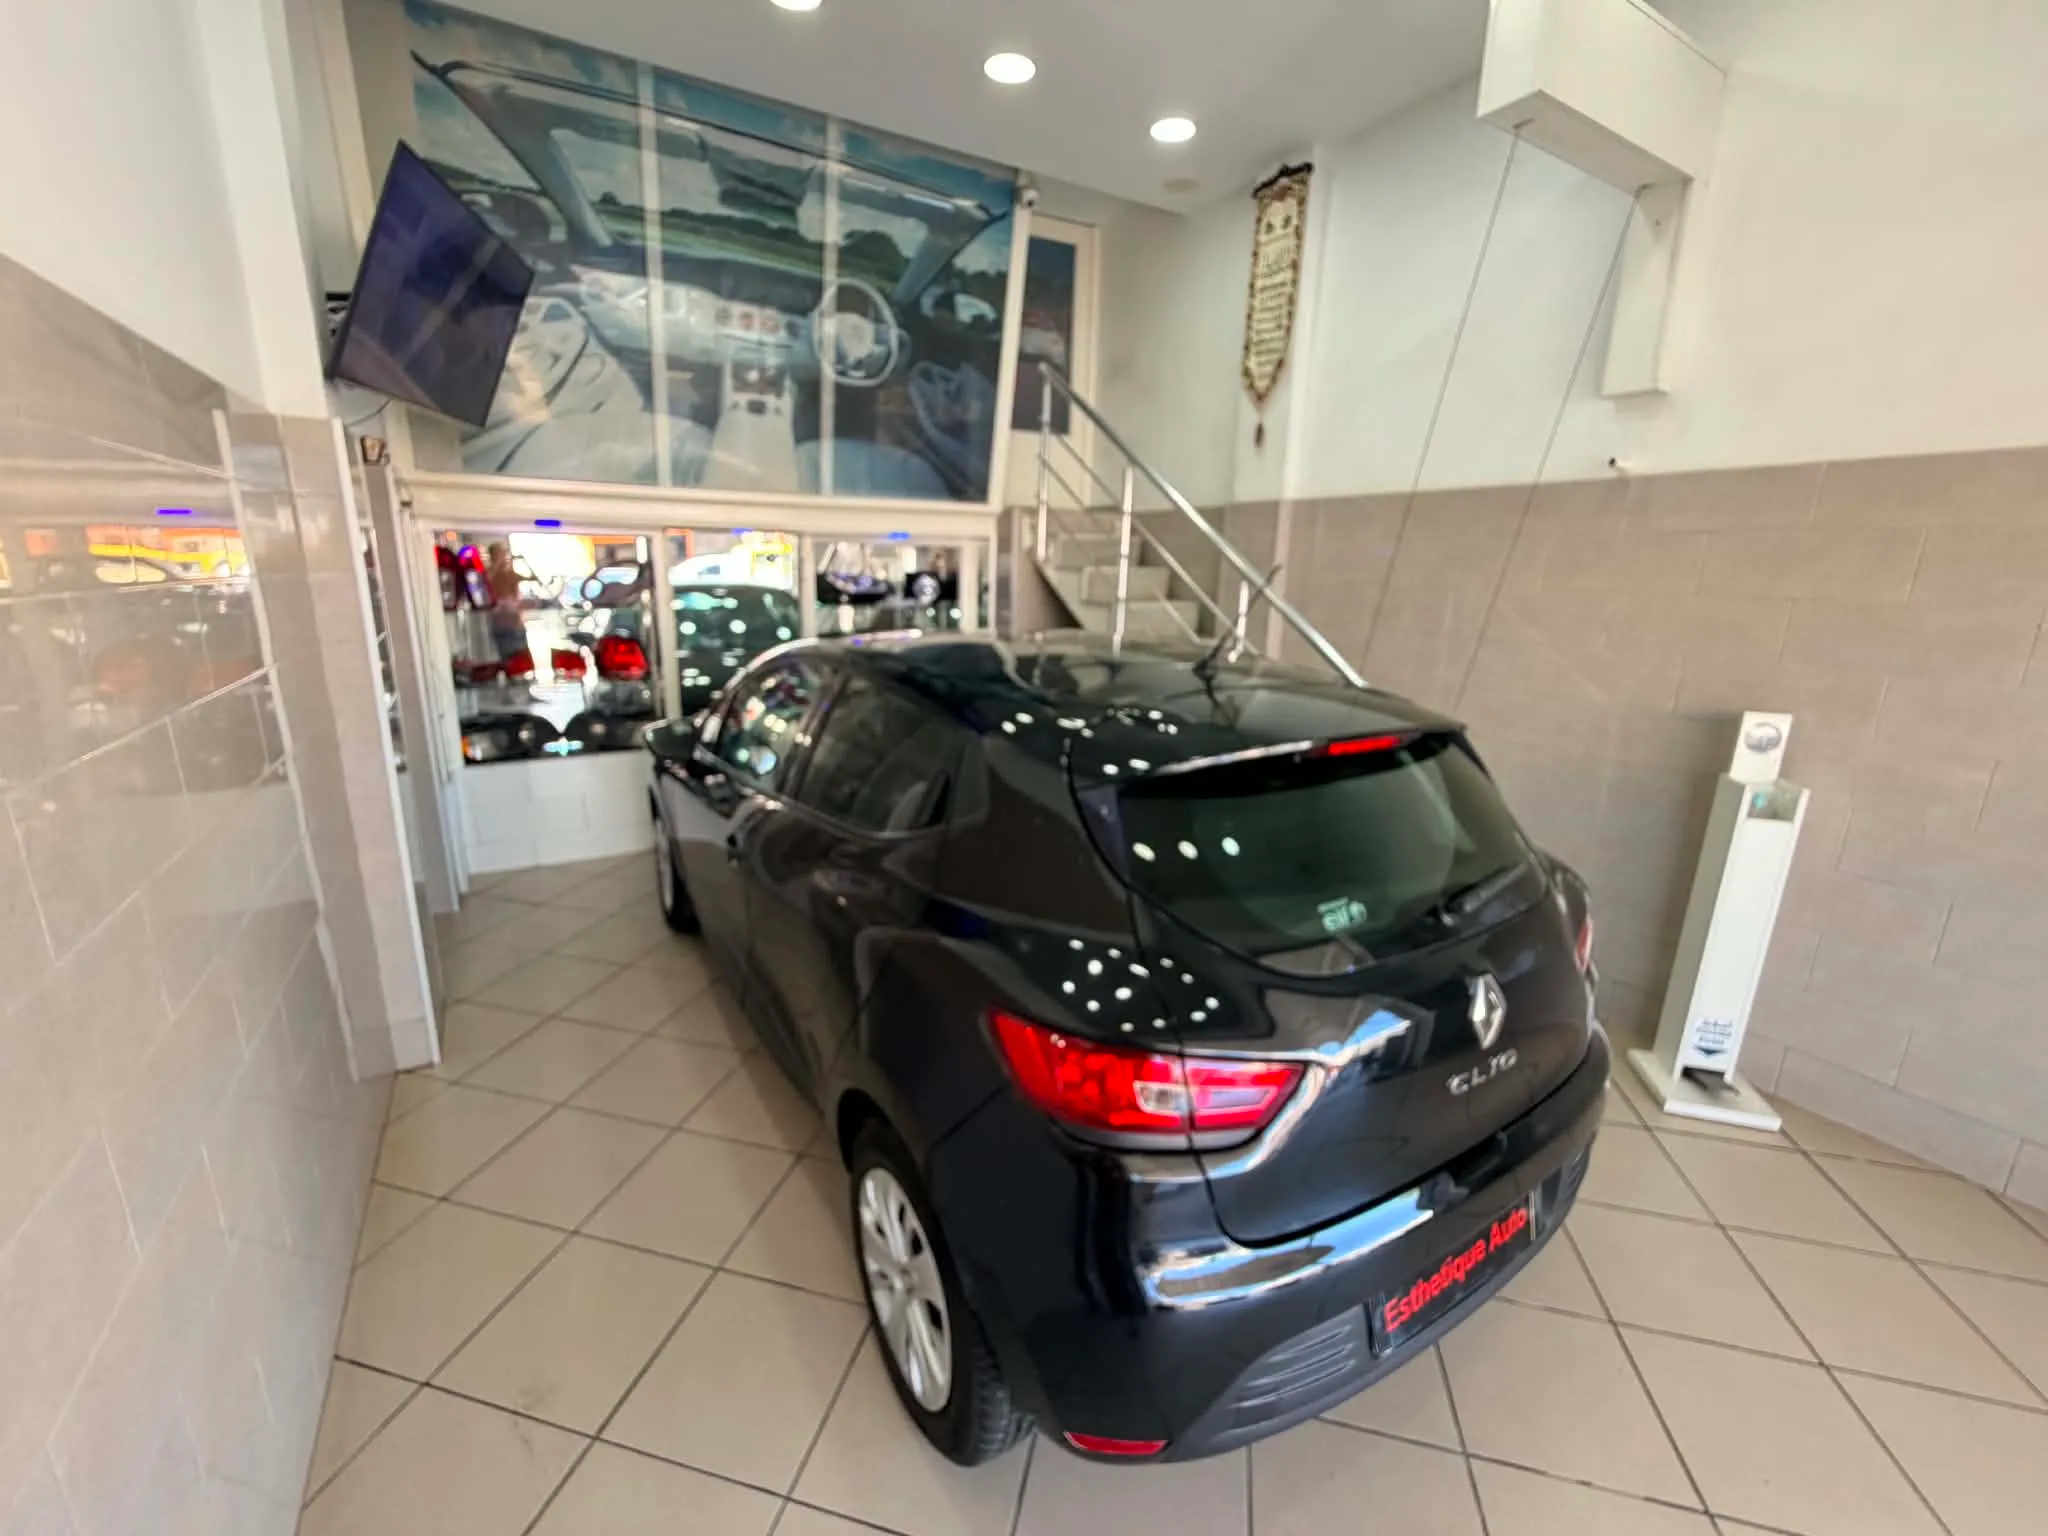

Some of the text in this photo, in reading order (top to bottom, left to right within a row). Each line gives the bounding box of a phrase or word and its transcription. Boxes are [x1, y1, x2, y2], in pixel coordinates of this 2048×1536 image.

[1446, 1048, 1518, 1095] CLIO
[1384, 1207, 1528, 1333] Esthetique Auto
